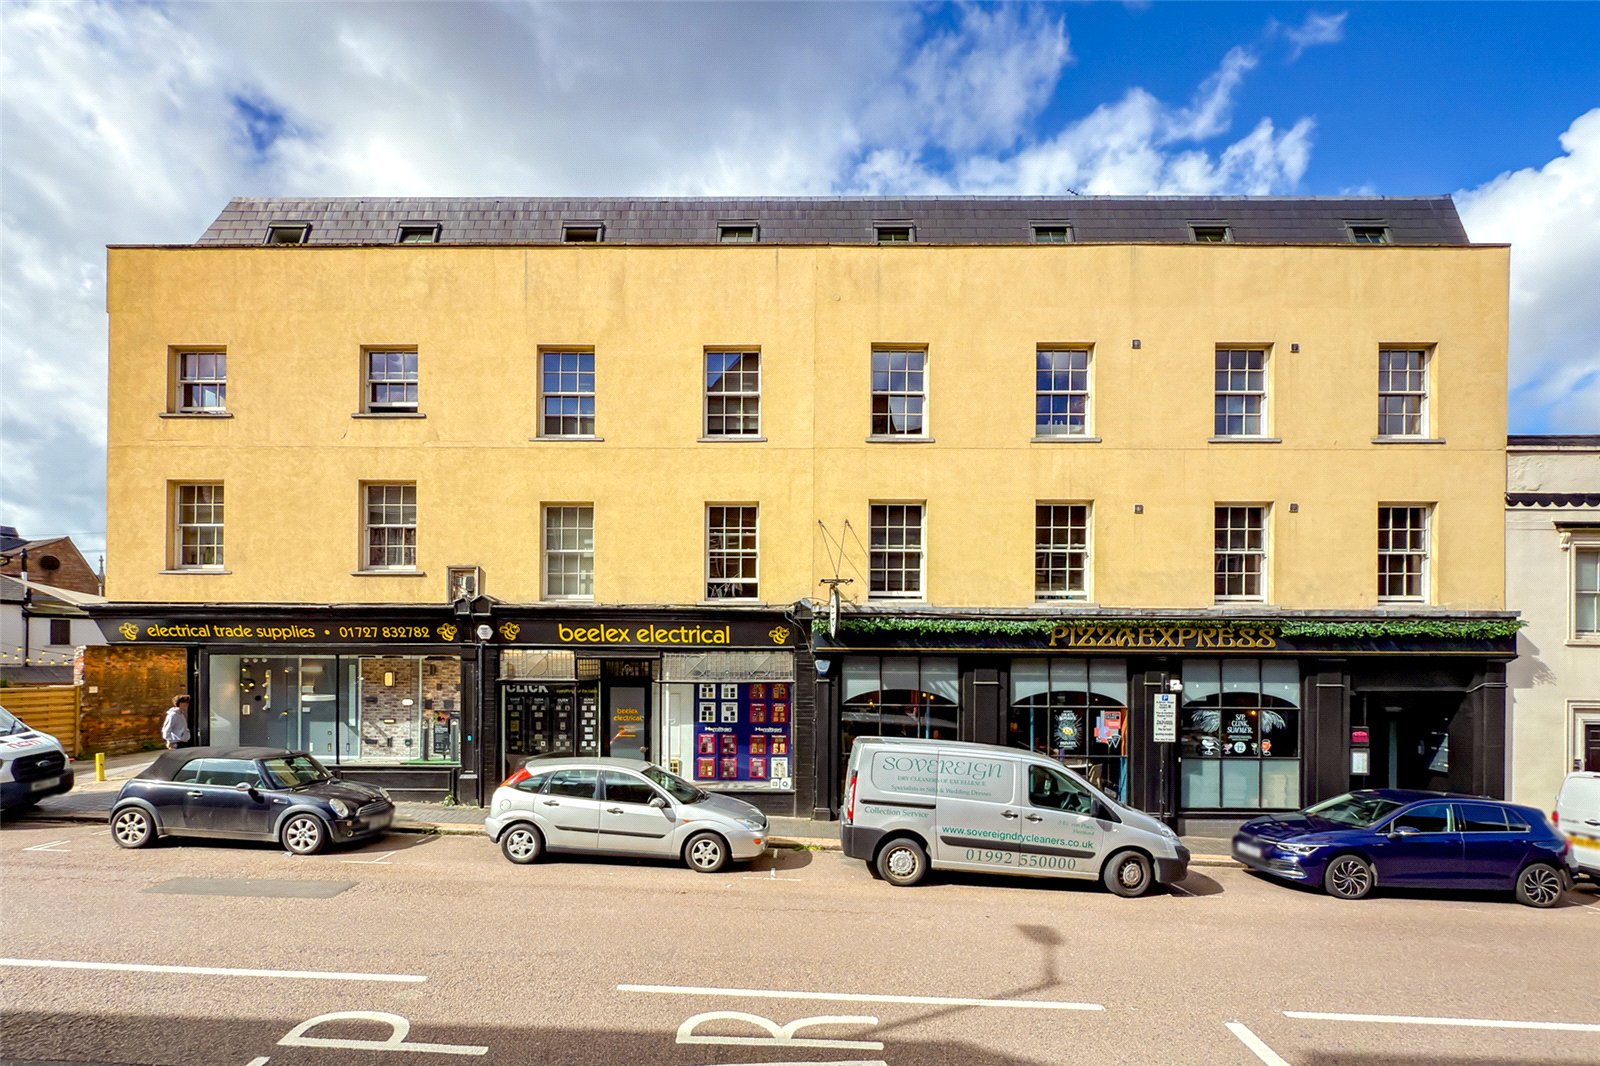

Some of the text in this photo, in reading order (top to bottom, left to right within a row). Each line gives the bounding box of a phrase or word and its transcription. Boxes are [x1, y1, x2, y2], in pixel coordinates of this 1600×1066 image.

[147, 624, 430, 640] electrical trade supplies 01727 832782
[558, 623, 731, 644] beelex electrical
[1049, 626, 1277, 648] PIZZAEXPRESS
[882, 756, 1003, 780] SOVEREIGN
[864, 806, 930, 819] Collection Service
[942, 826, 1094, 849] www.sovereigndrycleaners.co.uk
[966, 849, 1077, 870] 01992 550000
